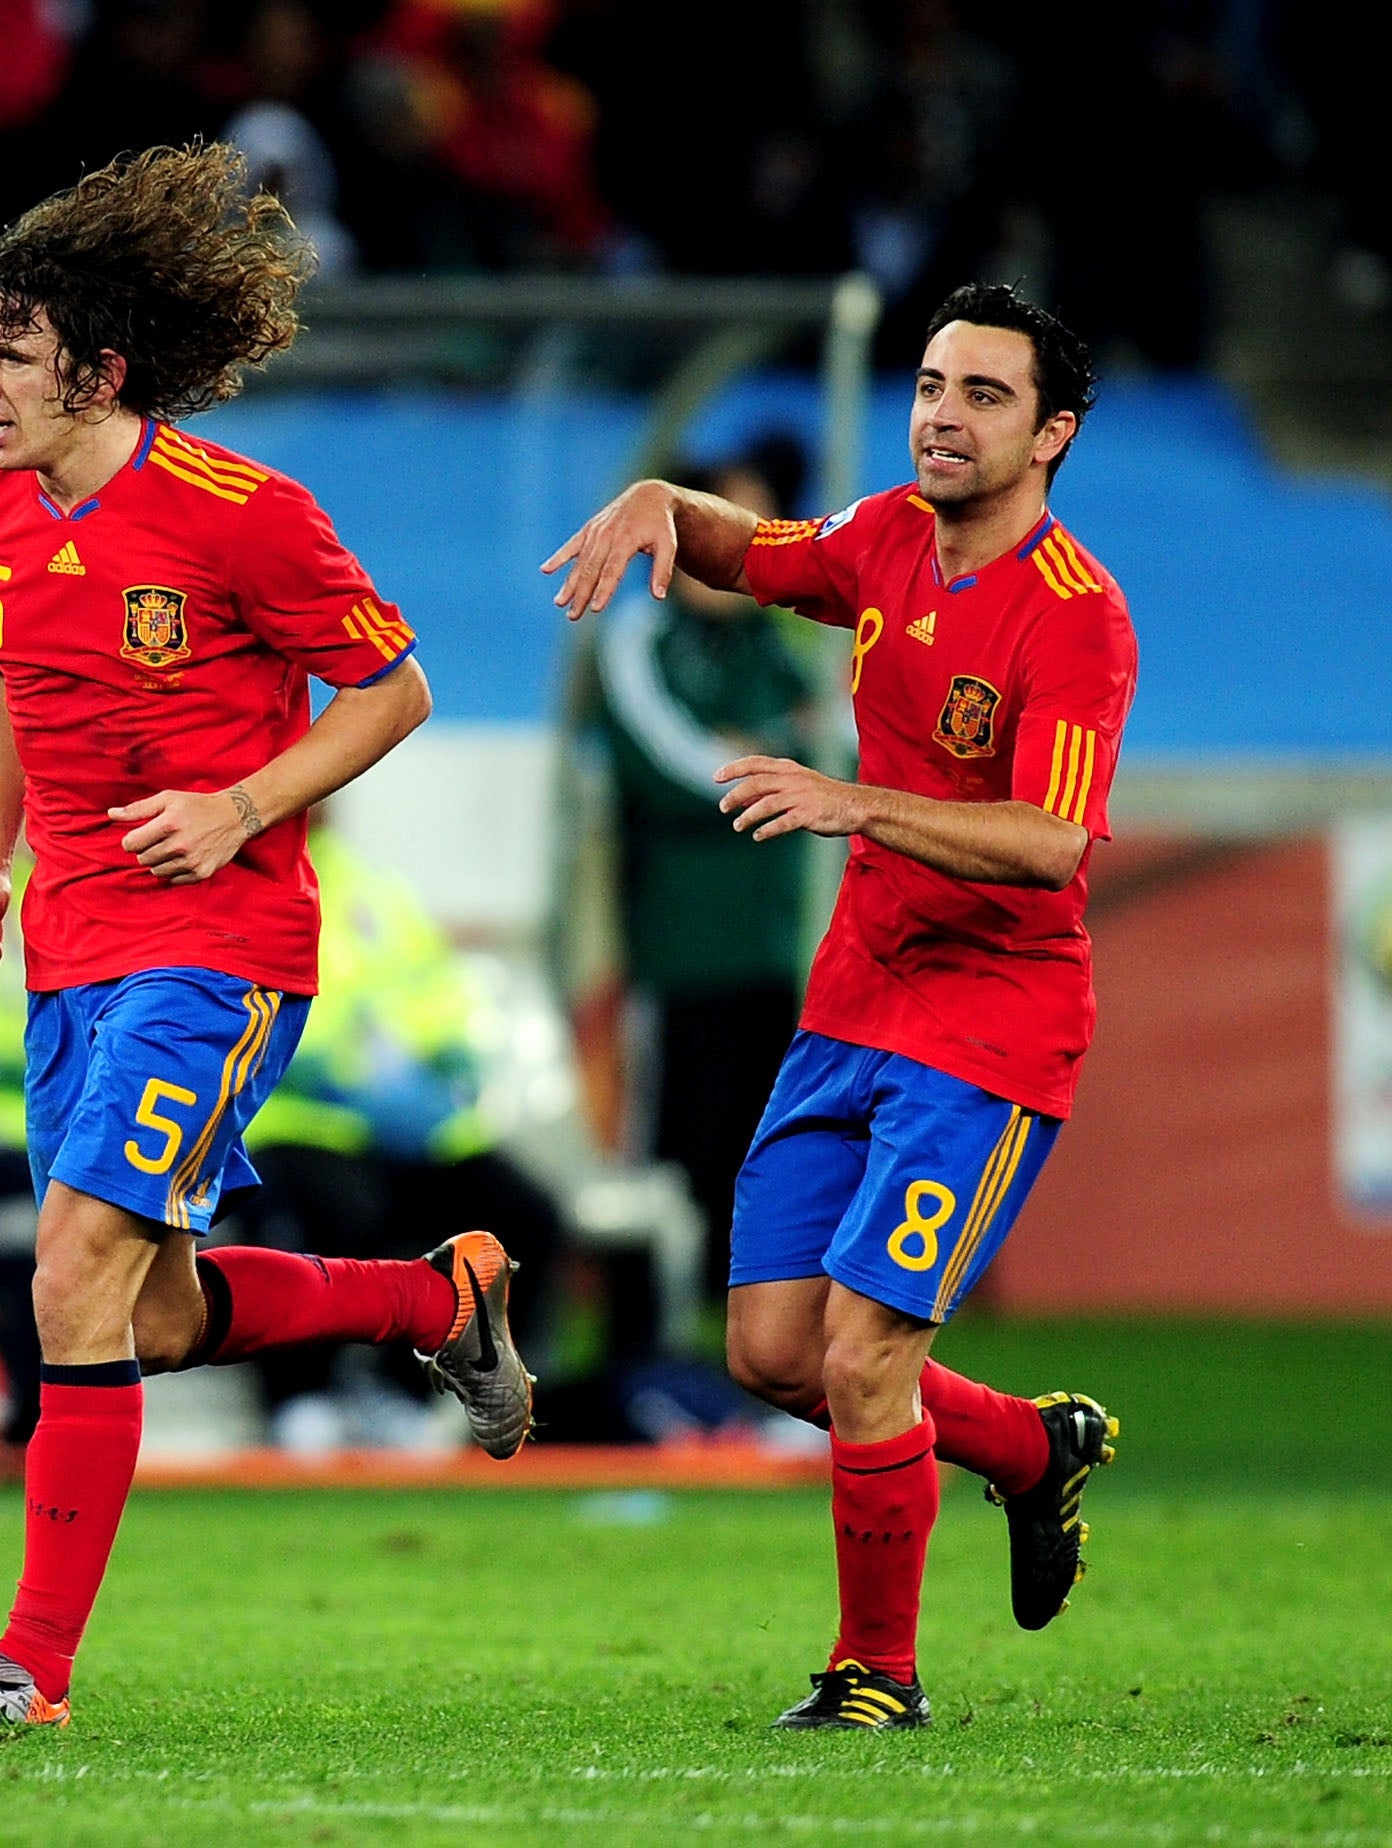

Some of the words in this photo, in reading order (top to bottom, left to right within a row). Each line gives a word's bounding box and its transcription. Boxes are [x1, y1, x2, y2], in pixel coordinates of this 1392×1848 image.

[48, 562, 86, 576] adidas
[124, 1078, 197, 1175] 5
[887, 1179, 956, 1272] 8
